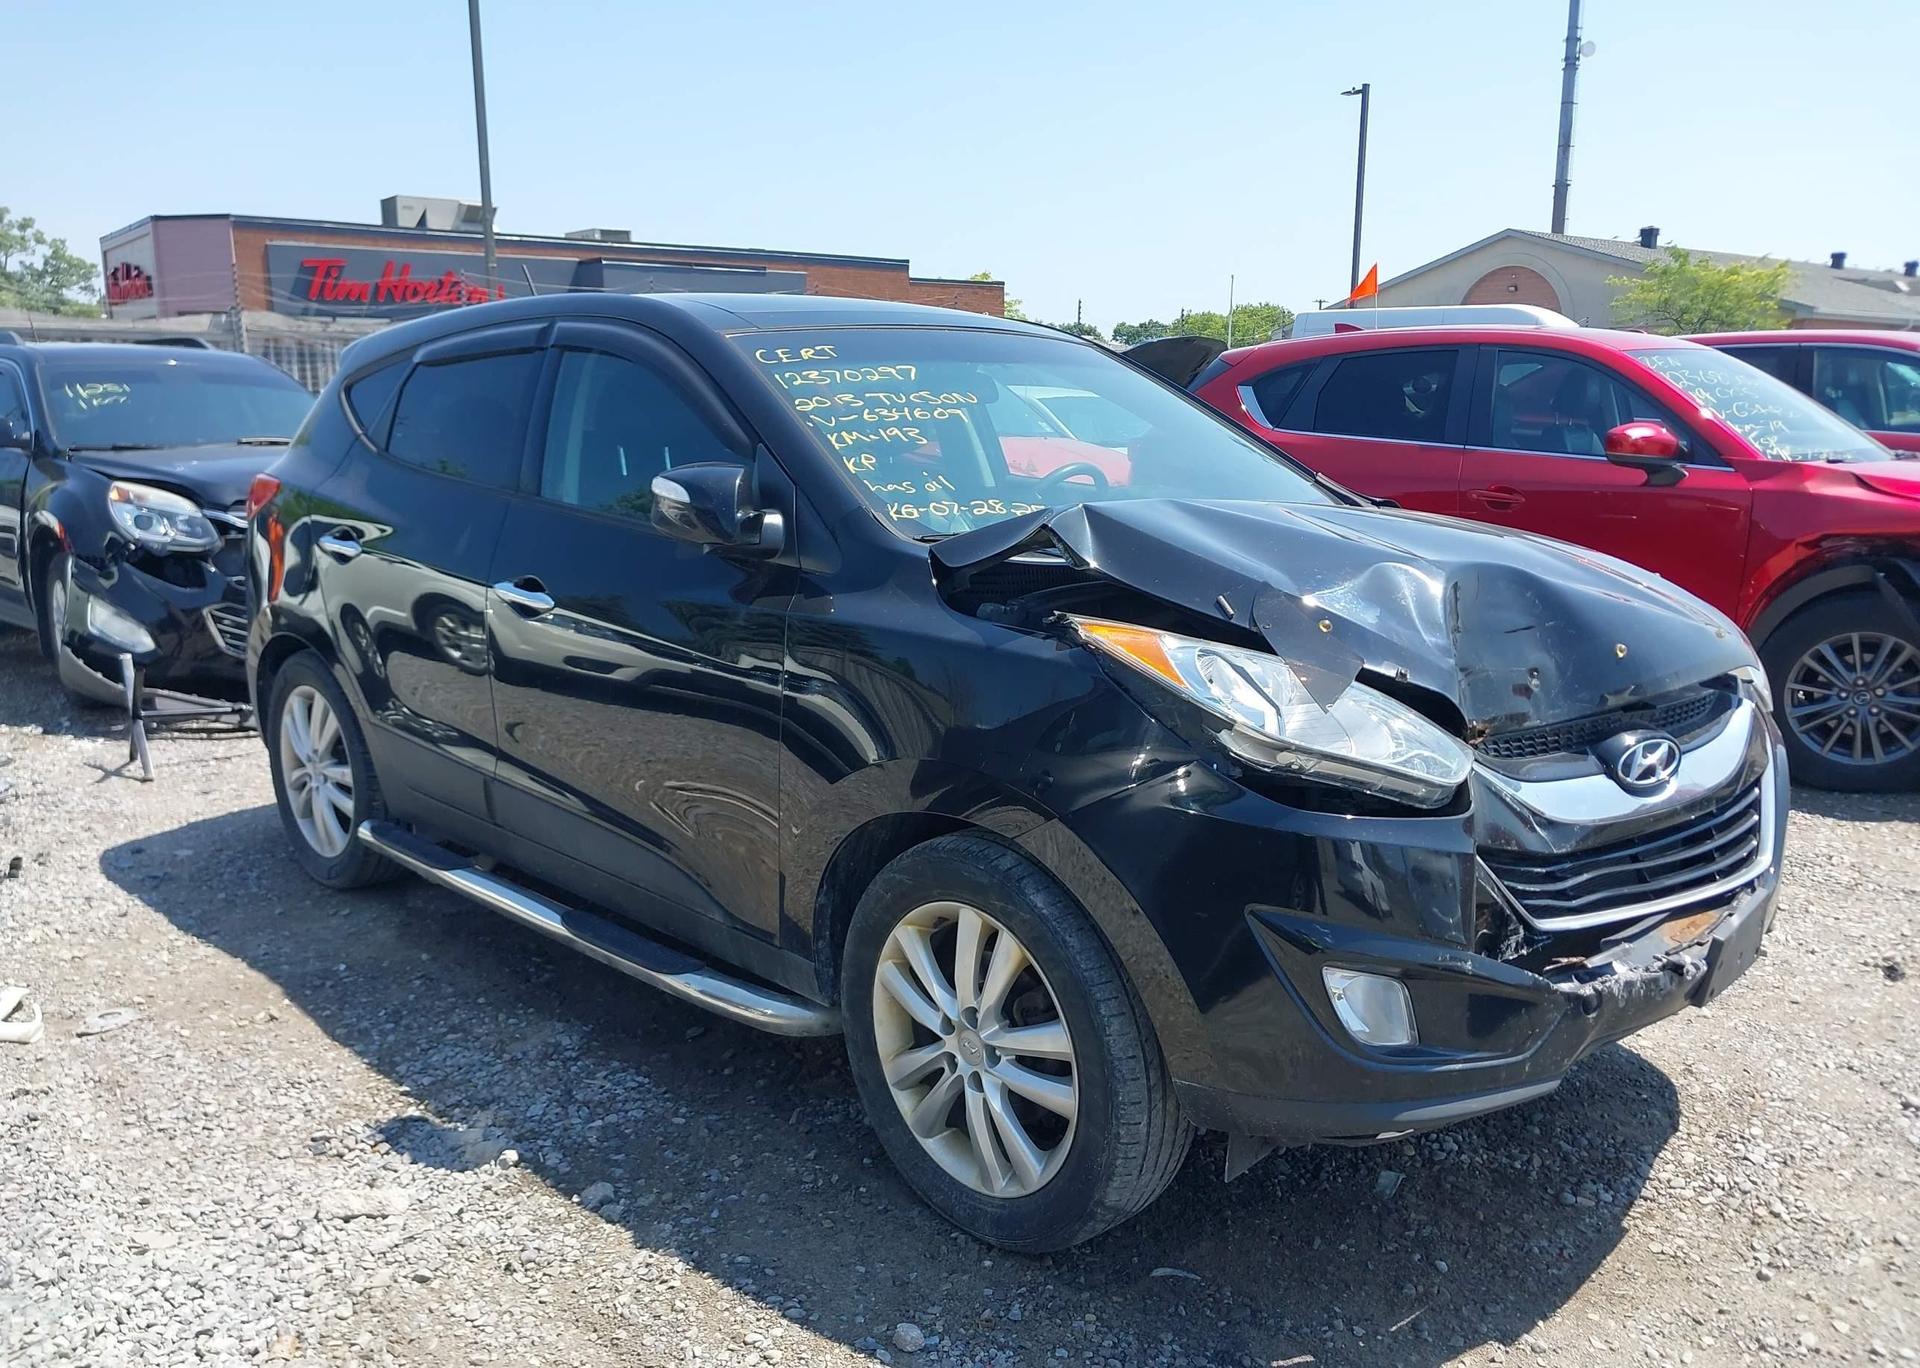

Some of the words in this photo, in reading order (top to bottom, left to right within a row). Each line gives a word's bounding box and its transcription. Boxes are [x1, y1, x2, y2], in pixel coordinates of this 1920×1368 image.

[303, 257, 371, 303] Tim
[755, 345, 838, 364] CERT
[774, 365, 917, 389] 12370297
[794, 393, 864, 411] 2013
[864, 391, 978, 406] TUCSON
[863, 479, 917, 494] has
[922, 471, 956, 493] oil
